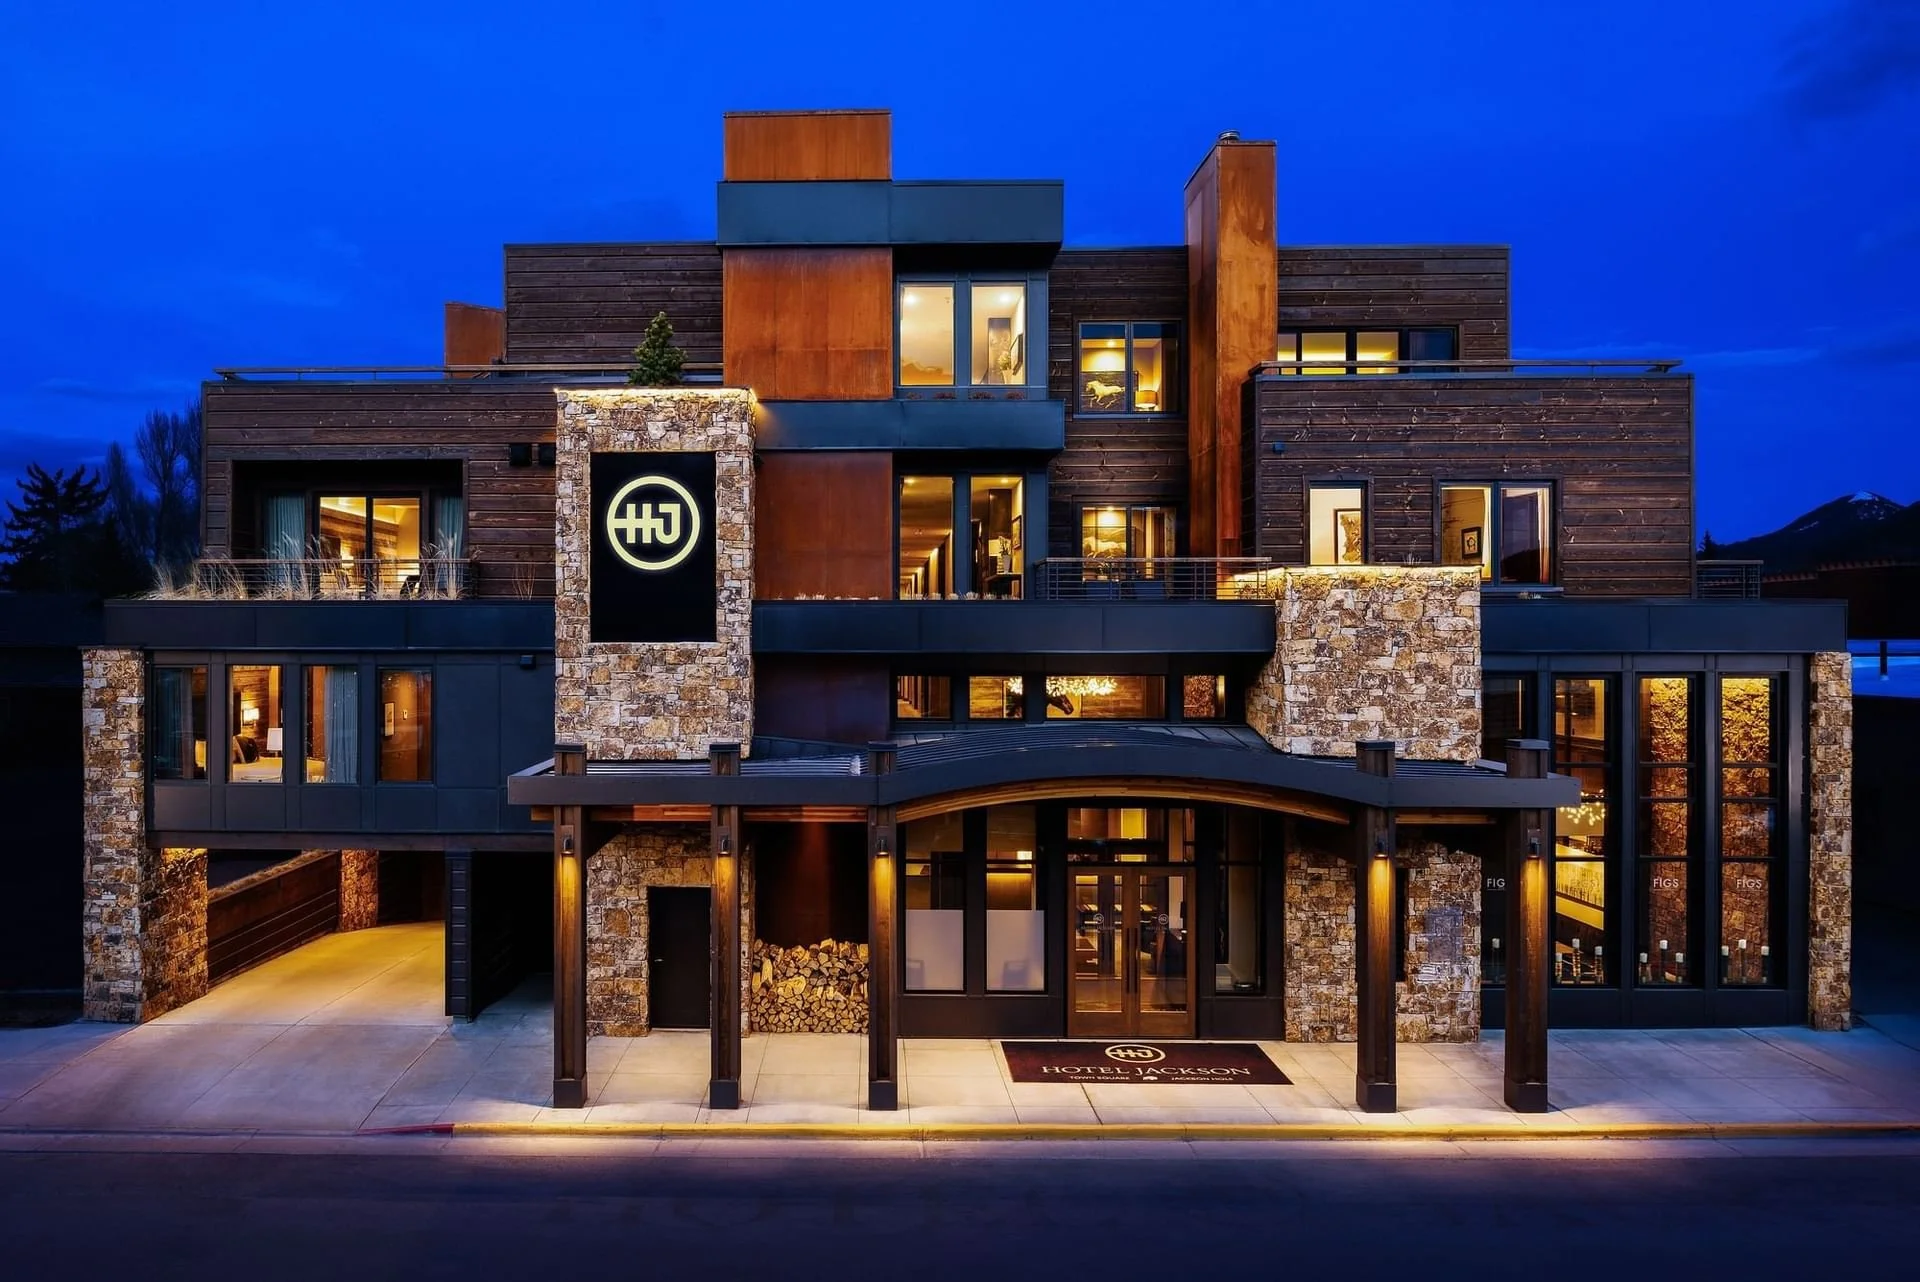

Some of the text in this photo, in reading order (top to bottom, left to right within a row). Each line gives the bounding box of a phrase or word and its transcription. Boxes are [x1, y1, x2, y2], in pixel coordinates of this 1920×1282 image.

[621, 503, 681, 544] HJ
[1487, 878, 1506, 888] FIG
[1653, 878, 1679, 888] FIGS
[1736, 878, 1762, 889] FIGS
[1042, 1066, 1251, 1076] HOTEL JACKSON
